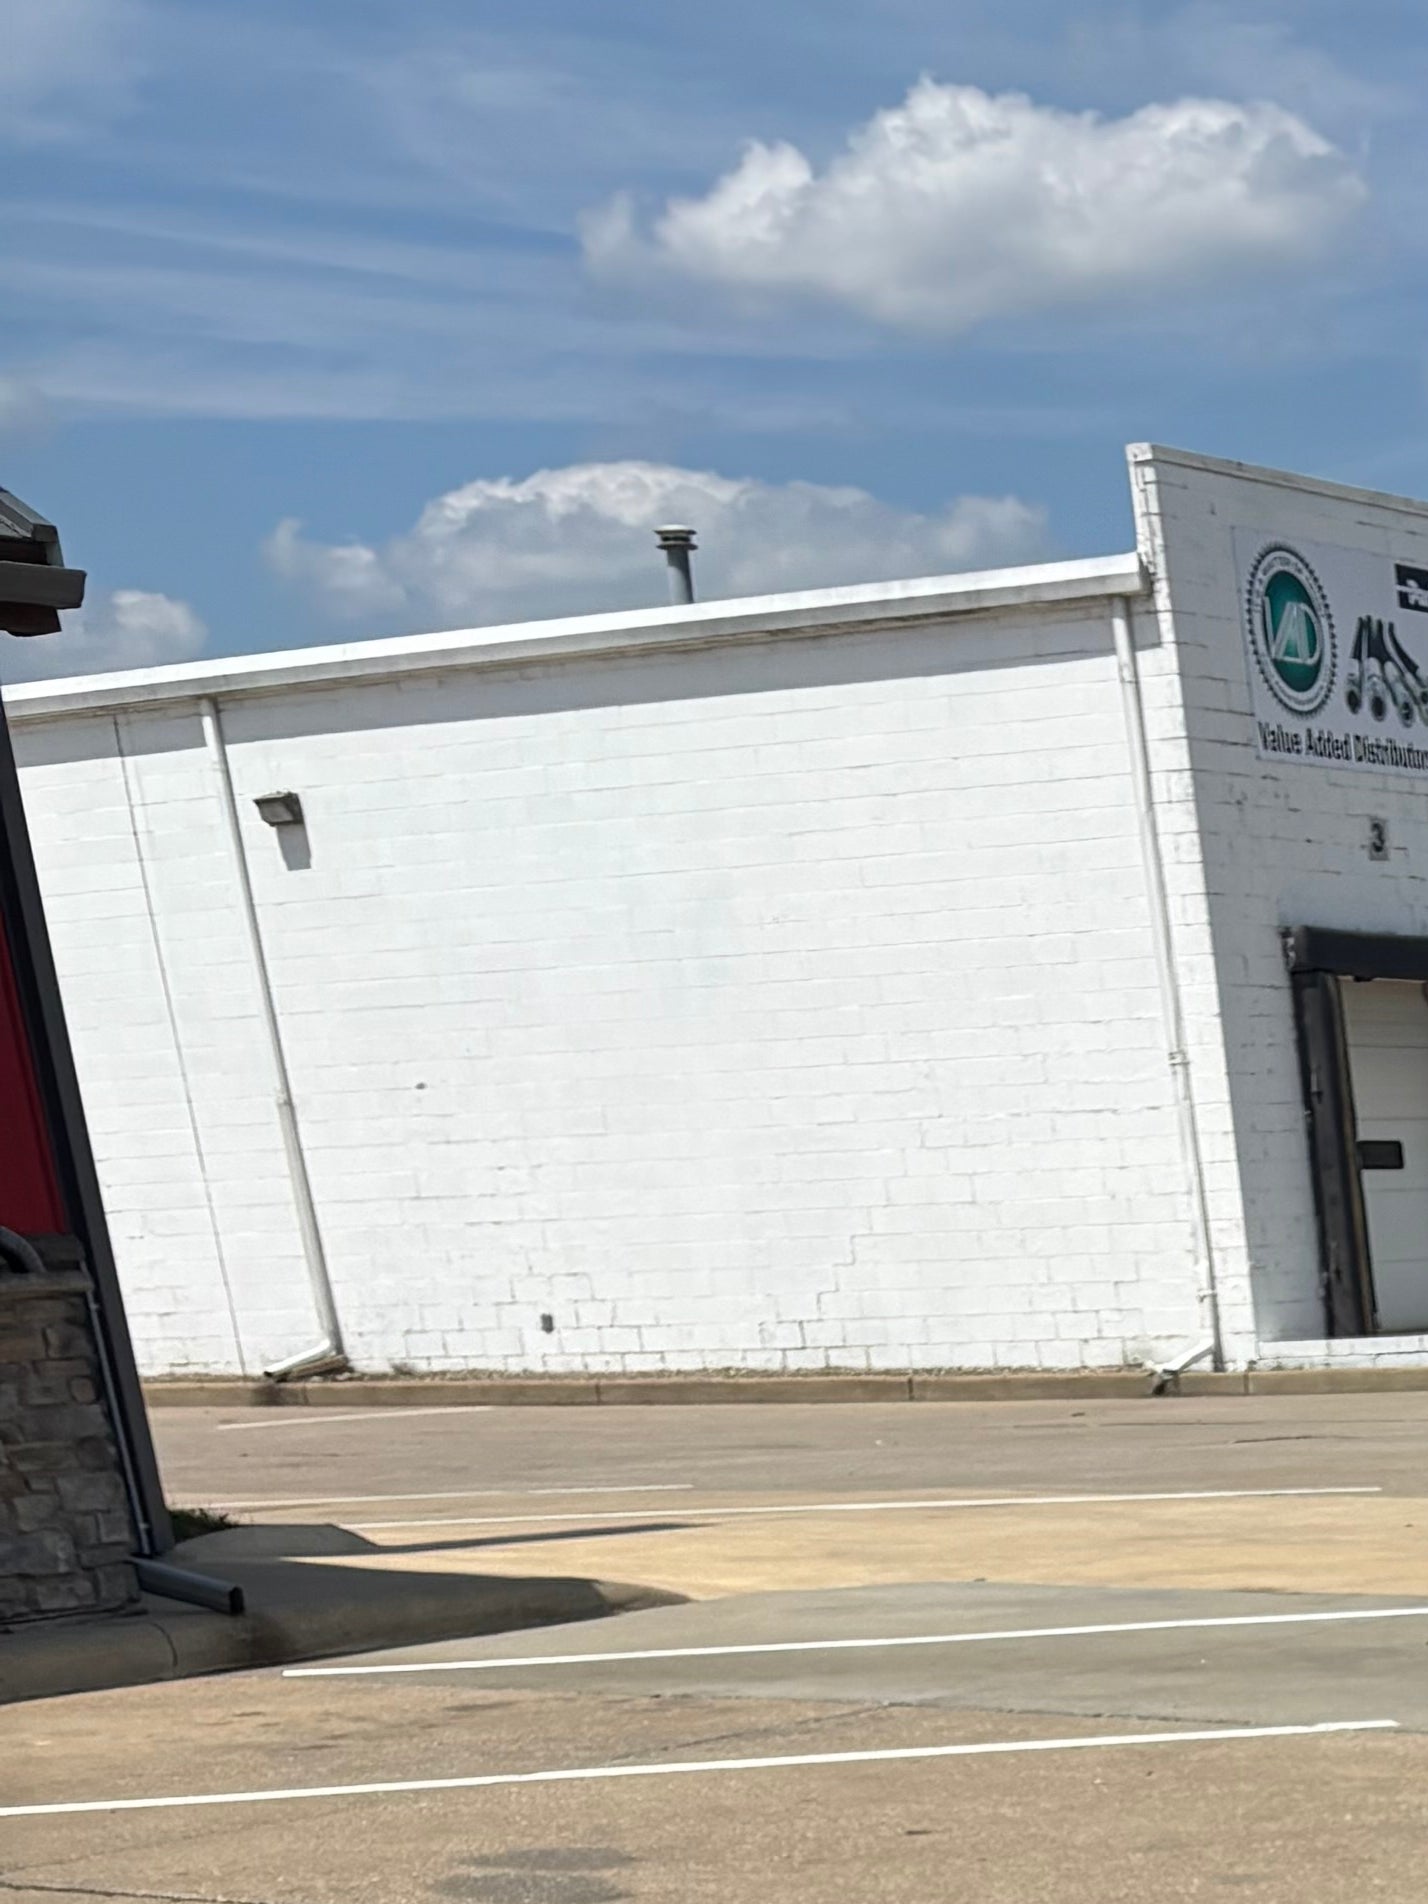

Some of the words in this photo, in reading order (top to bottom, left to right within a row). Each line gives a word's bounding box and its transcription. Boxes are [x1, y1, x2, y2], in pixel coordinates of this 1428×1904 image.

[1257, 721, 1303, 754] Value
[1304, 727, 1351, 761] Added
[1371, 821, 1386, 853] 3
